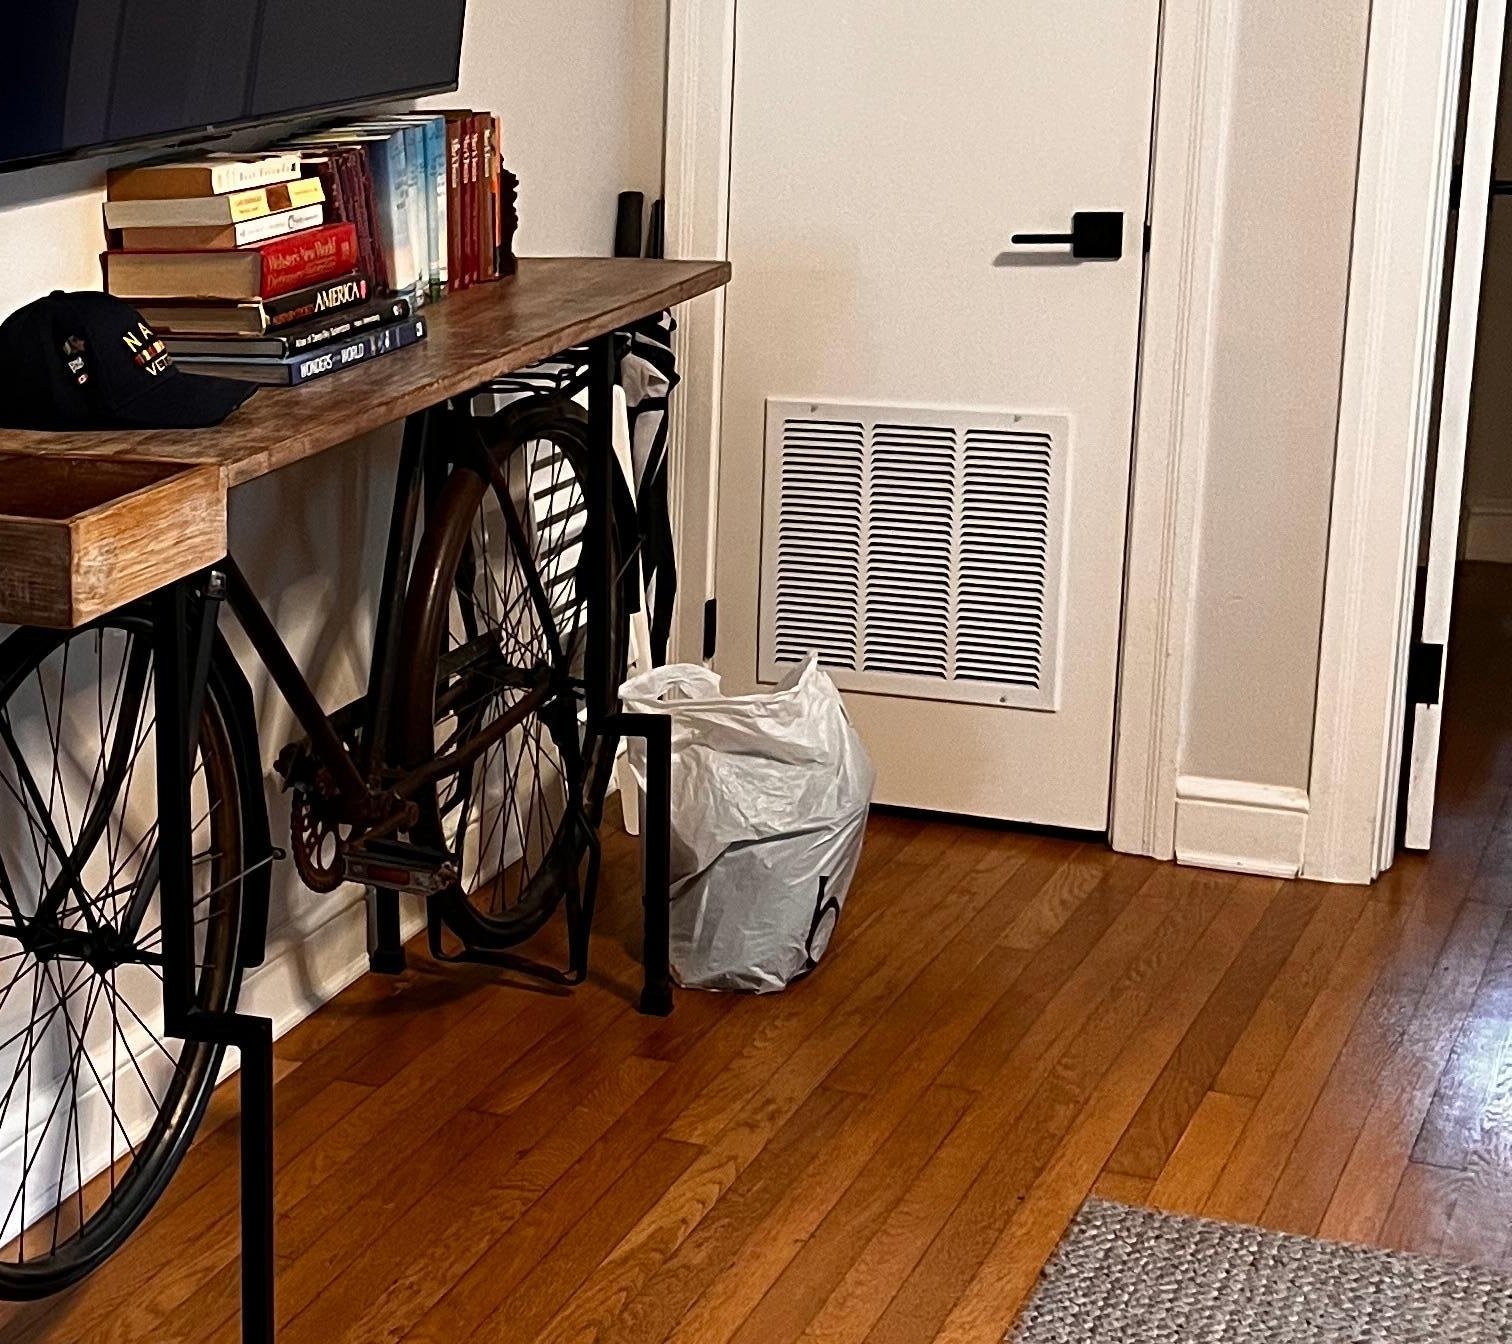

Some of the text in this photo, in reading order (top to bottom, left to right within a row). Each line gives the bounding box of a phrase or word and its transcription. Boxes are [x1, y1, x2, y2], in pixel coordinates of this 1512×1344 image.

[314, 281, 359, 312] AMERICA
[300, 343, 365, 378] WONDERS WORLD
